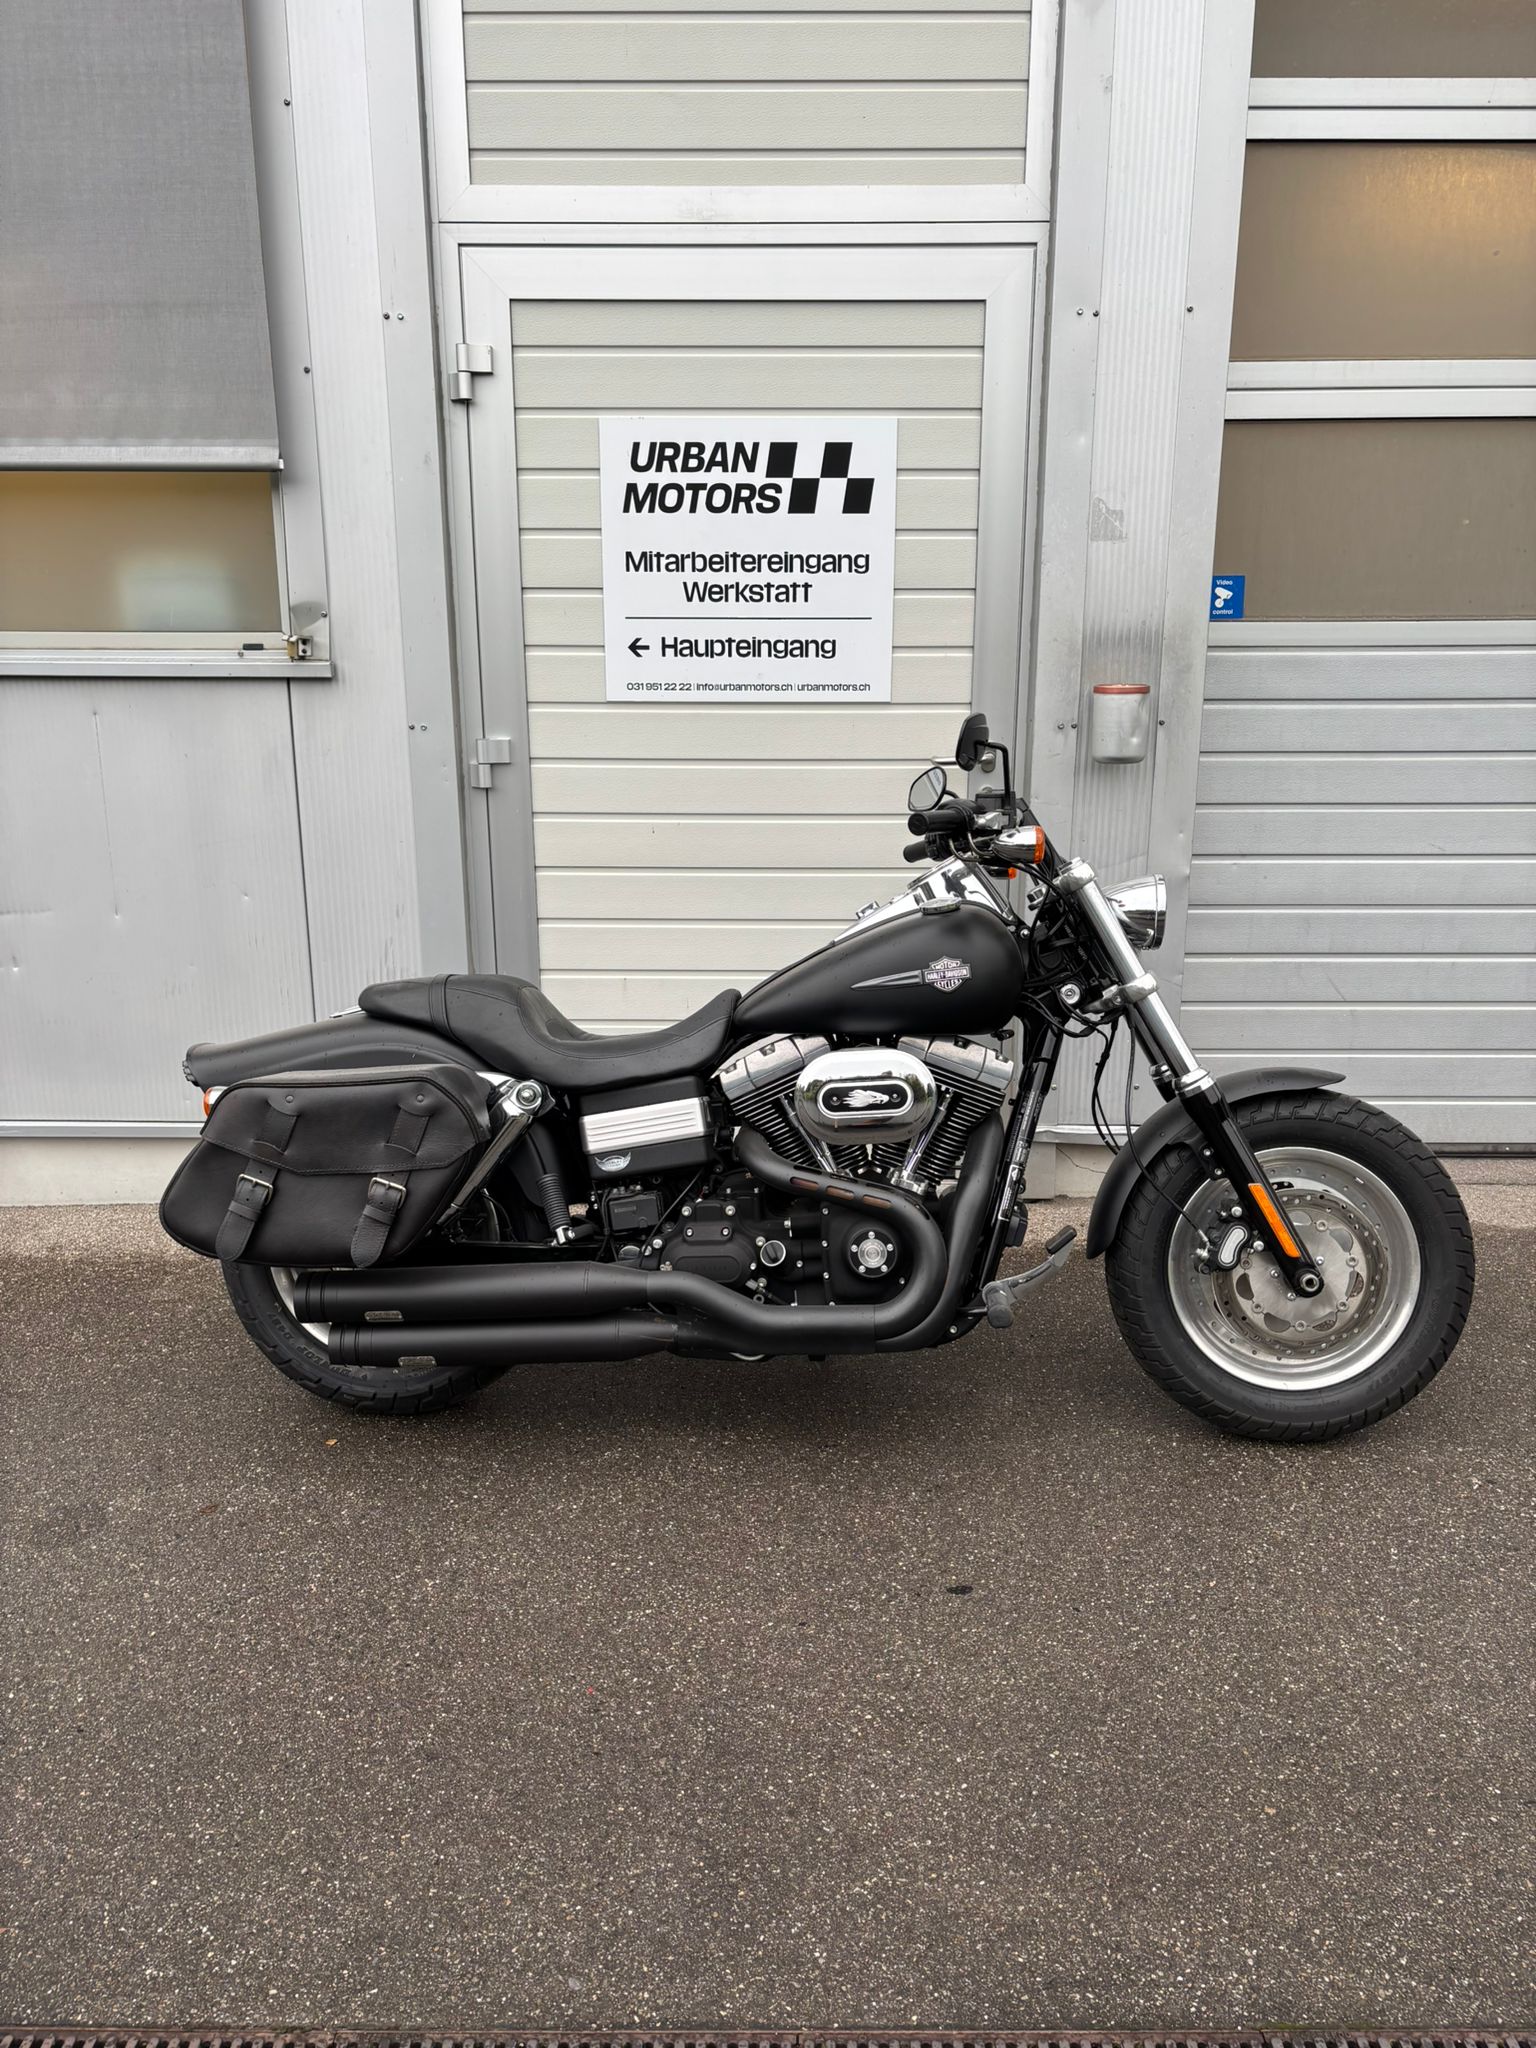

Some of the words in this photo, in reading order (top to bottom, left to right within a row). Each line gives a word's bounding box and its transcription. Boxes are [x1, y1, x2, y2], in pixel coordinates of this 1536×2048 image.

[630, 441, 760, 473] URBAN
[622, 483, 783, 514] MOTORS
[625, 551, 870, 574] Mitarbeitereingang
[682, 581, 813, 603] Werkstatt
[661, 636, 837, 659] Haupteingang
[664, 682, 678, 692] 22
[679, 682, 692, 692] 22
[797, 682, 871, 692] urbanmotors.ch
